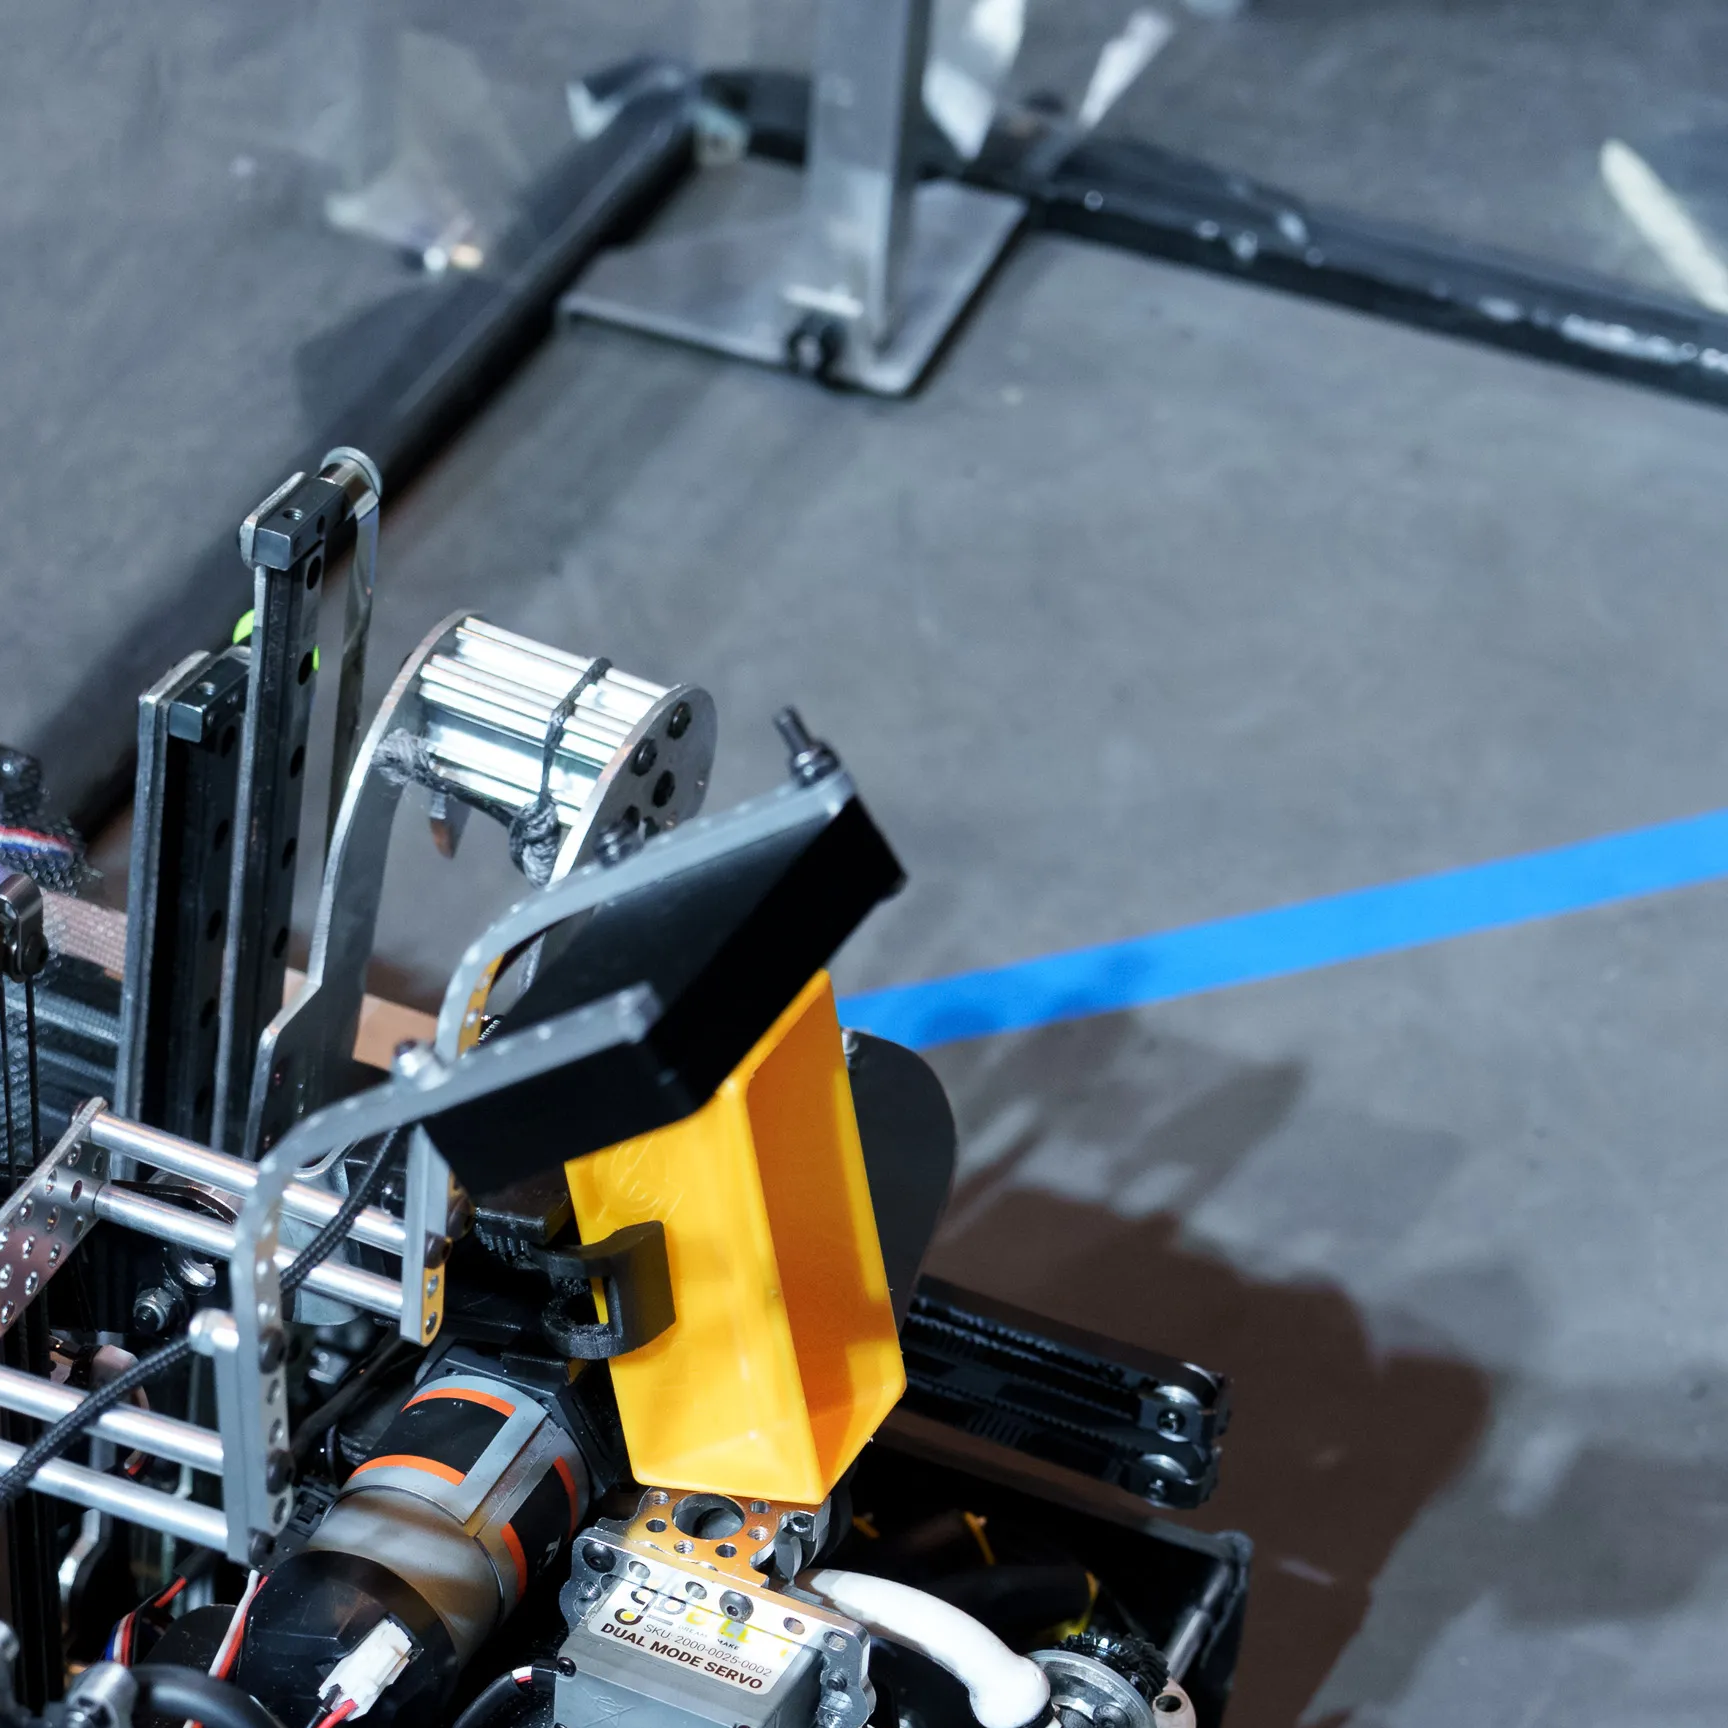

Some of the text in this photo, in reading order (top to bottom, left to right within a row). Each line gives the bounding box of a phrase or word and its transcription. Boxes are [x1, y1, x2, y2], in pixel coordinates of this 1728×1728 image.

[600, 1622, 763, 1690] DUAL MODE SERVO
[643, 1623, 772, 1677] SKU: 2000-0025-0002
